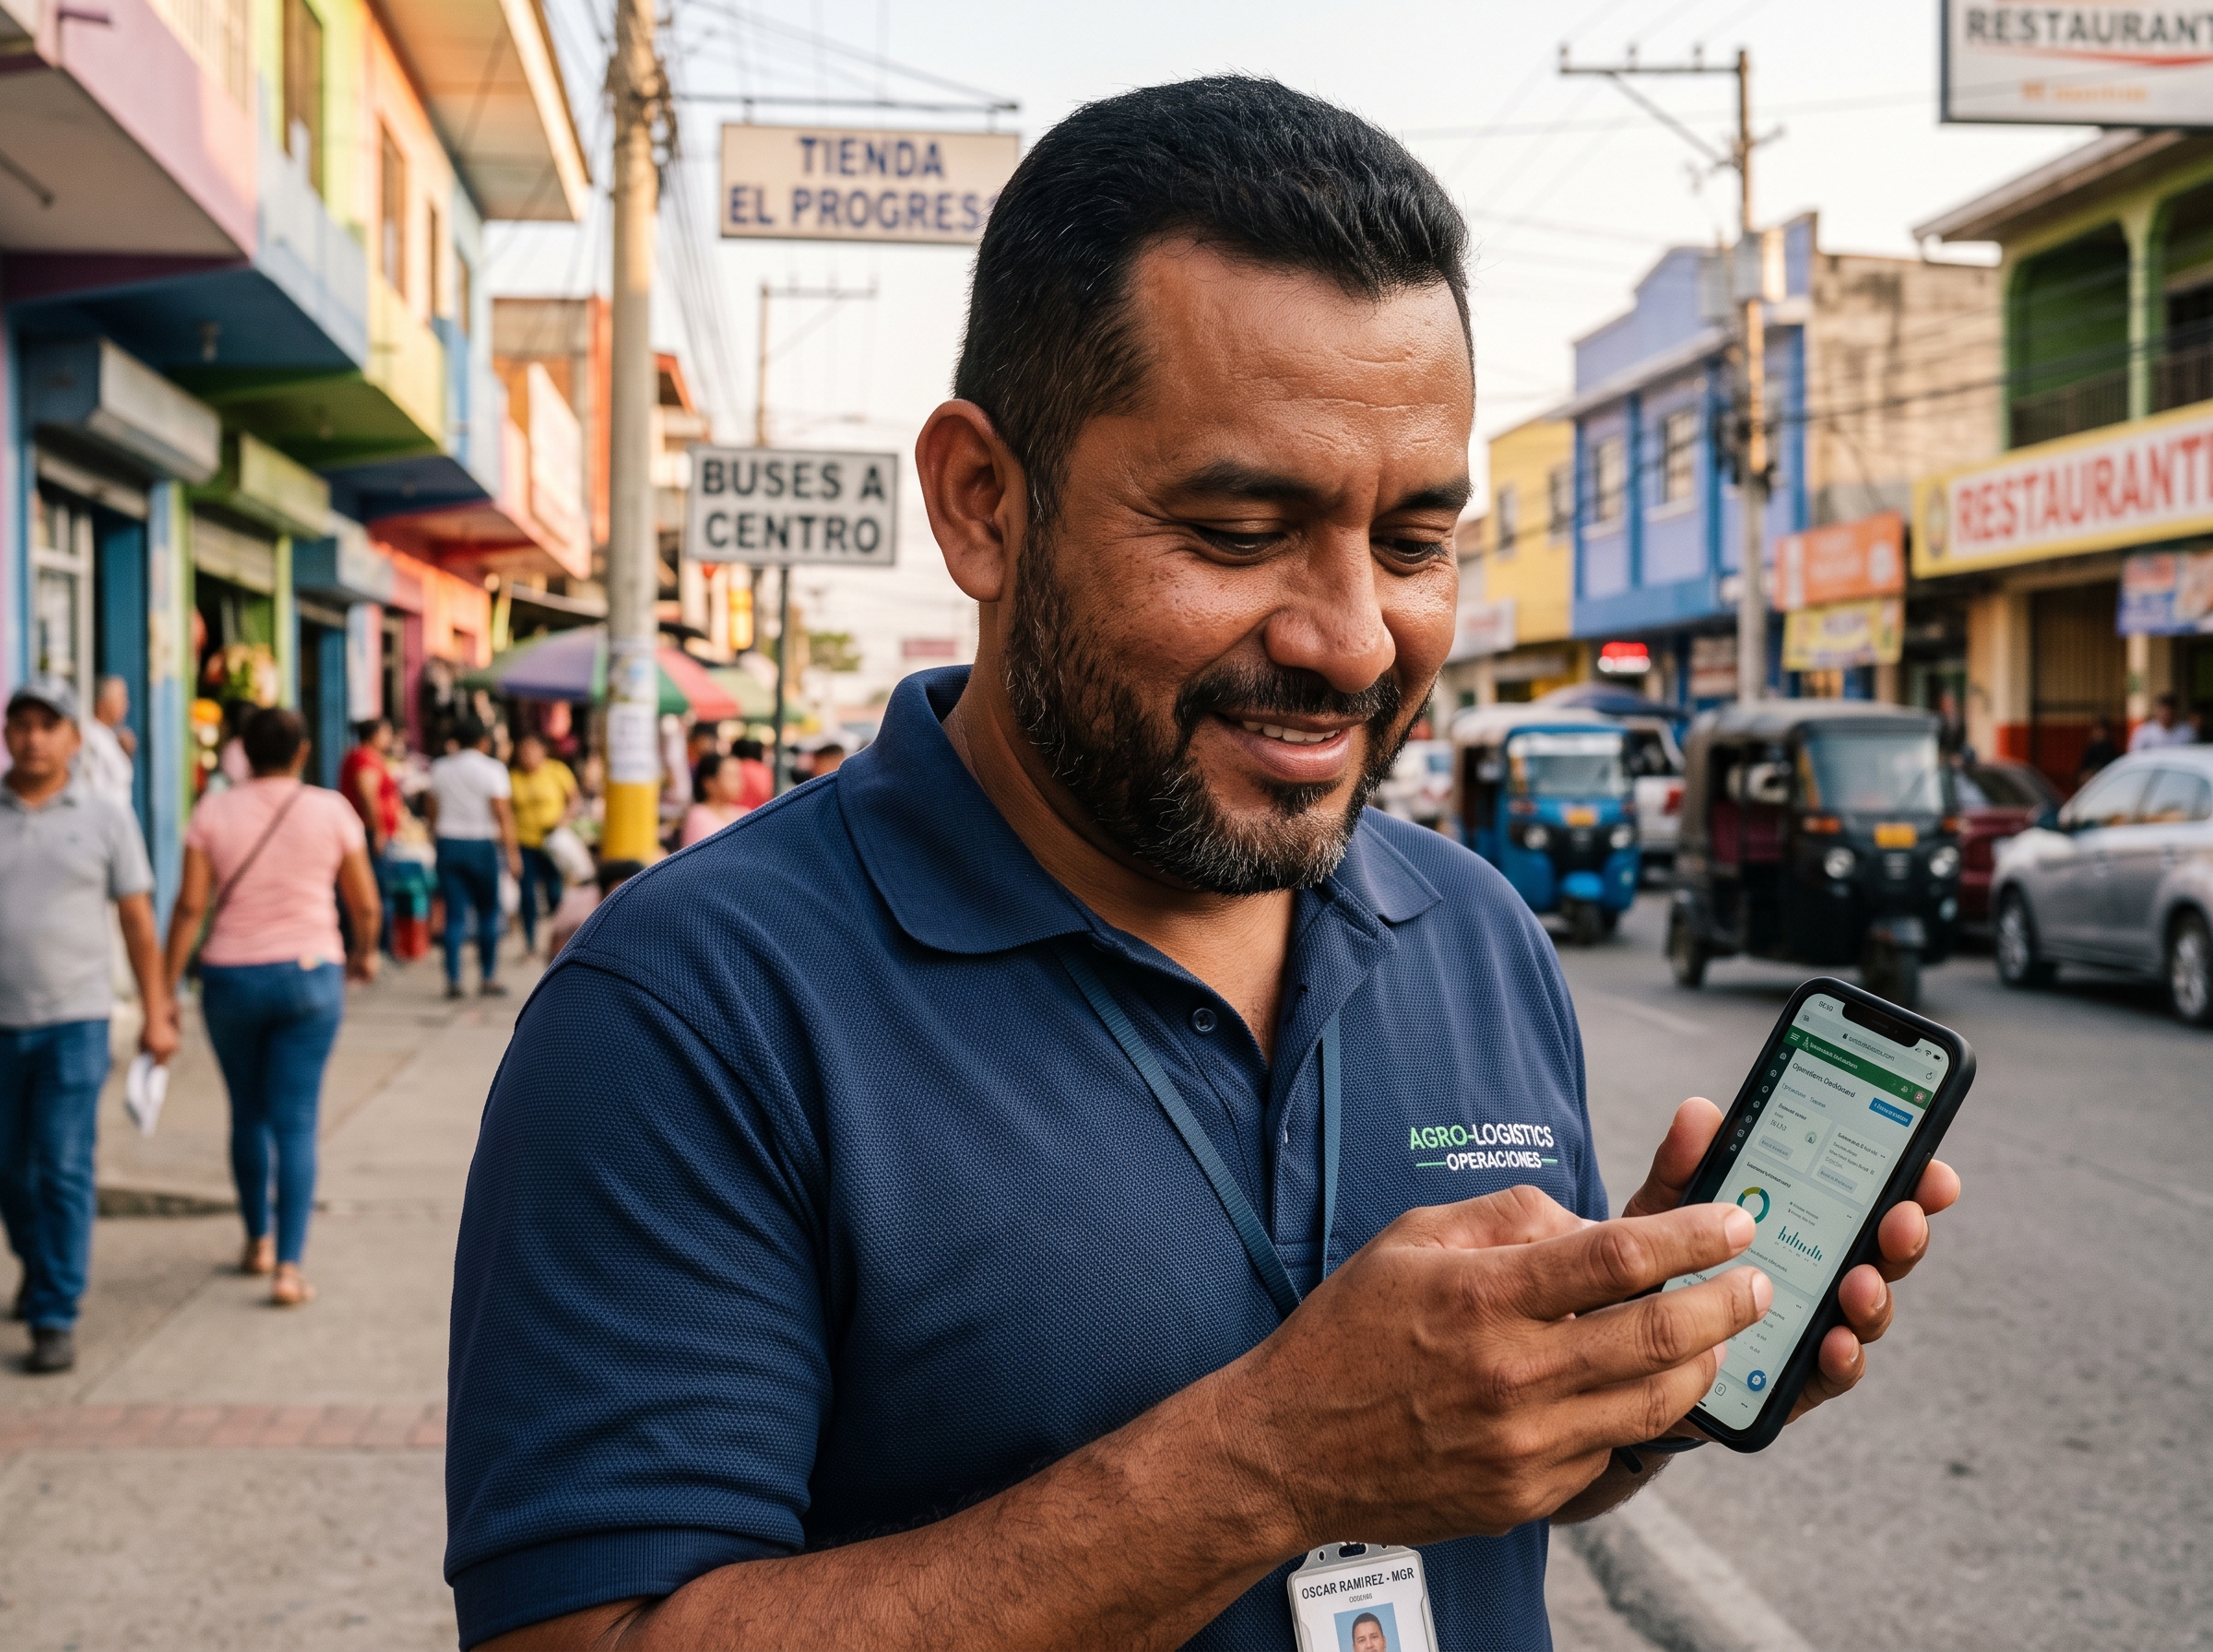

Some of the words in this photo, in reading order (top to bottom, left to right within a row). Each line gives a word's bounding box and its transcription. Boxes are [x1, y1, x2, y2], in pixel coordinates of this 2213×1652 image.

[799, 136, 945, 179] TIENDA
[728, 187, 776, 225] EL
[791, 188, 999, 232] PROGRES
[701, 459, 841, 499] BUSES
[859, 465, 886, 502] A
[1957, 433, 2213, 546] RESTAURANT
[704, 512, 882, 554] CENTRO
[1410, 1123, 1555, 1150] AGRO-LOGISTICS
[1446, 1150, 1542, 1171] OPERACIONES
[1301, 1582, 1337, 1599] OSCAR
[1339, 1573, 1385, 1593] RAMIREZ
[1391, 1567, 1414, 1582] MGR
